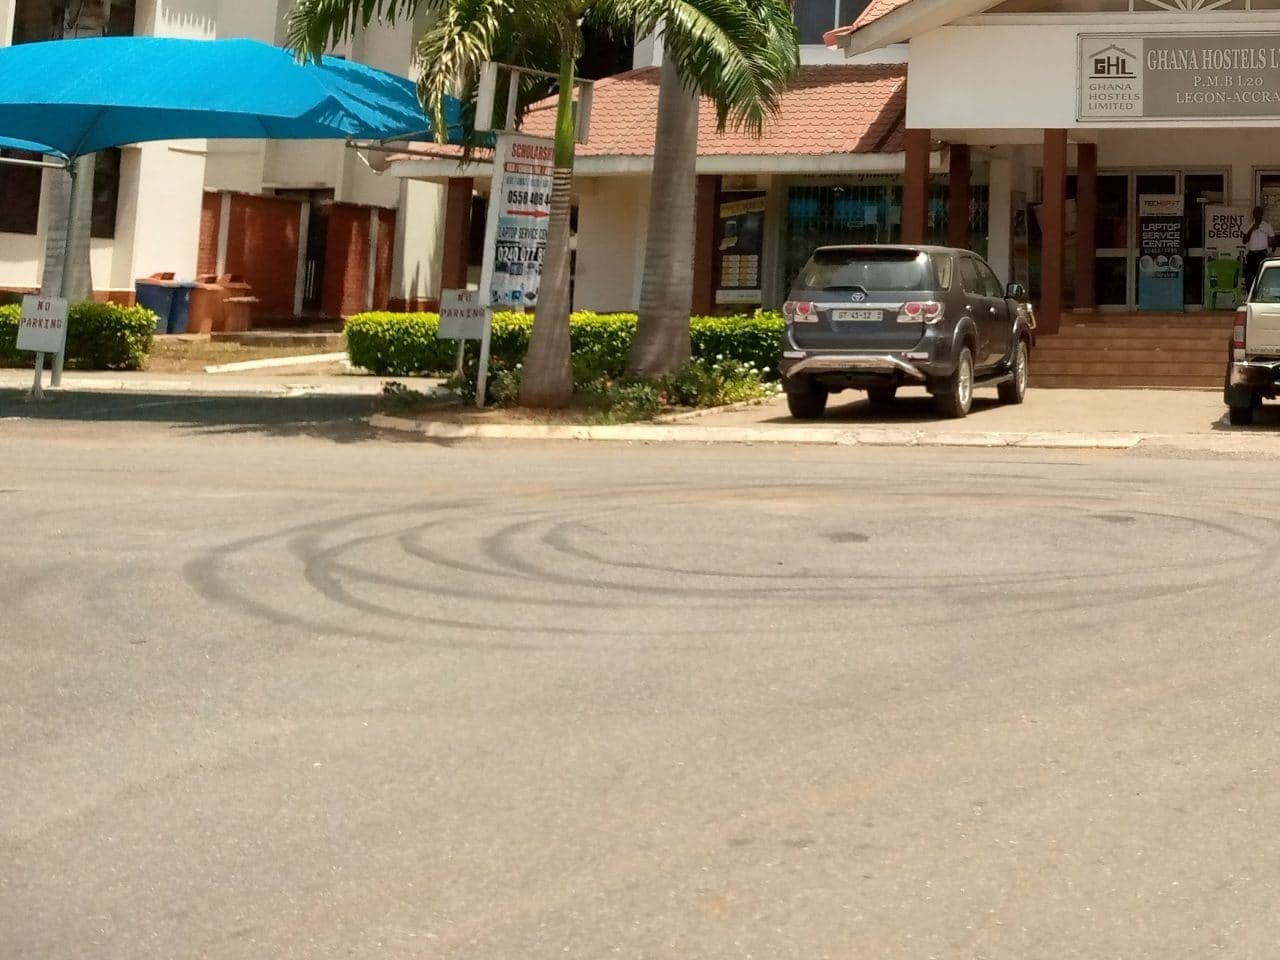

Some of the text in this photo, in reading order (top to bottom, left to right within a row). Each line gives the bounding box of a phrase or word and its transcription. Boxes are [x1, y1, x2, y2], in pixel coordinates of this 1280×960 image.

[1147, 49, 1199, 71] GHANA
[1201, 48, 1267, 70] HOSTELS
[1094, 56, 1134, 75] GHL
[1194, 75, 1233, 87] P.M.B
[1089, 83, 1132, 91] GHANA
[1089, 93, 1140, 101] HOSTELS
[1176, 91, 1280, 104] LEGON-ACCRA
[1089, 102, 1134, 110] LIMITED
[507, 190, 528, 204] 0558
[1212, 215, 1244, 223] PRINT
[1142, 223, 1180, 231] LAPTOP
[1213, 223, 1242, 231] COPY
[1142, 231, 1180, 239] SERVICE
[1142, 240, 1180, 248] CENTRE
[37, 300, 51, 311] NO
[20, 318, 62, 329] PARKING
